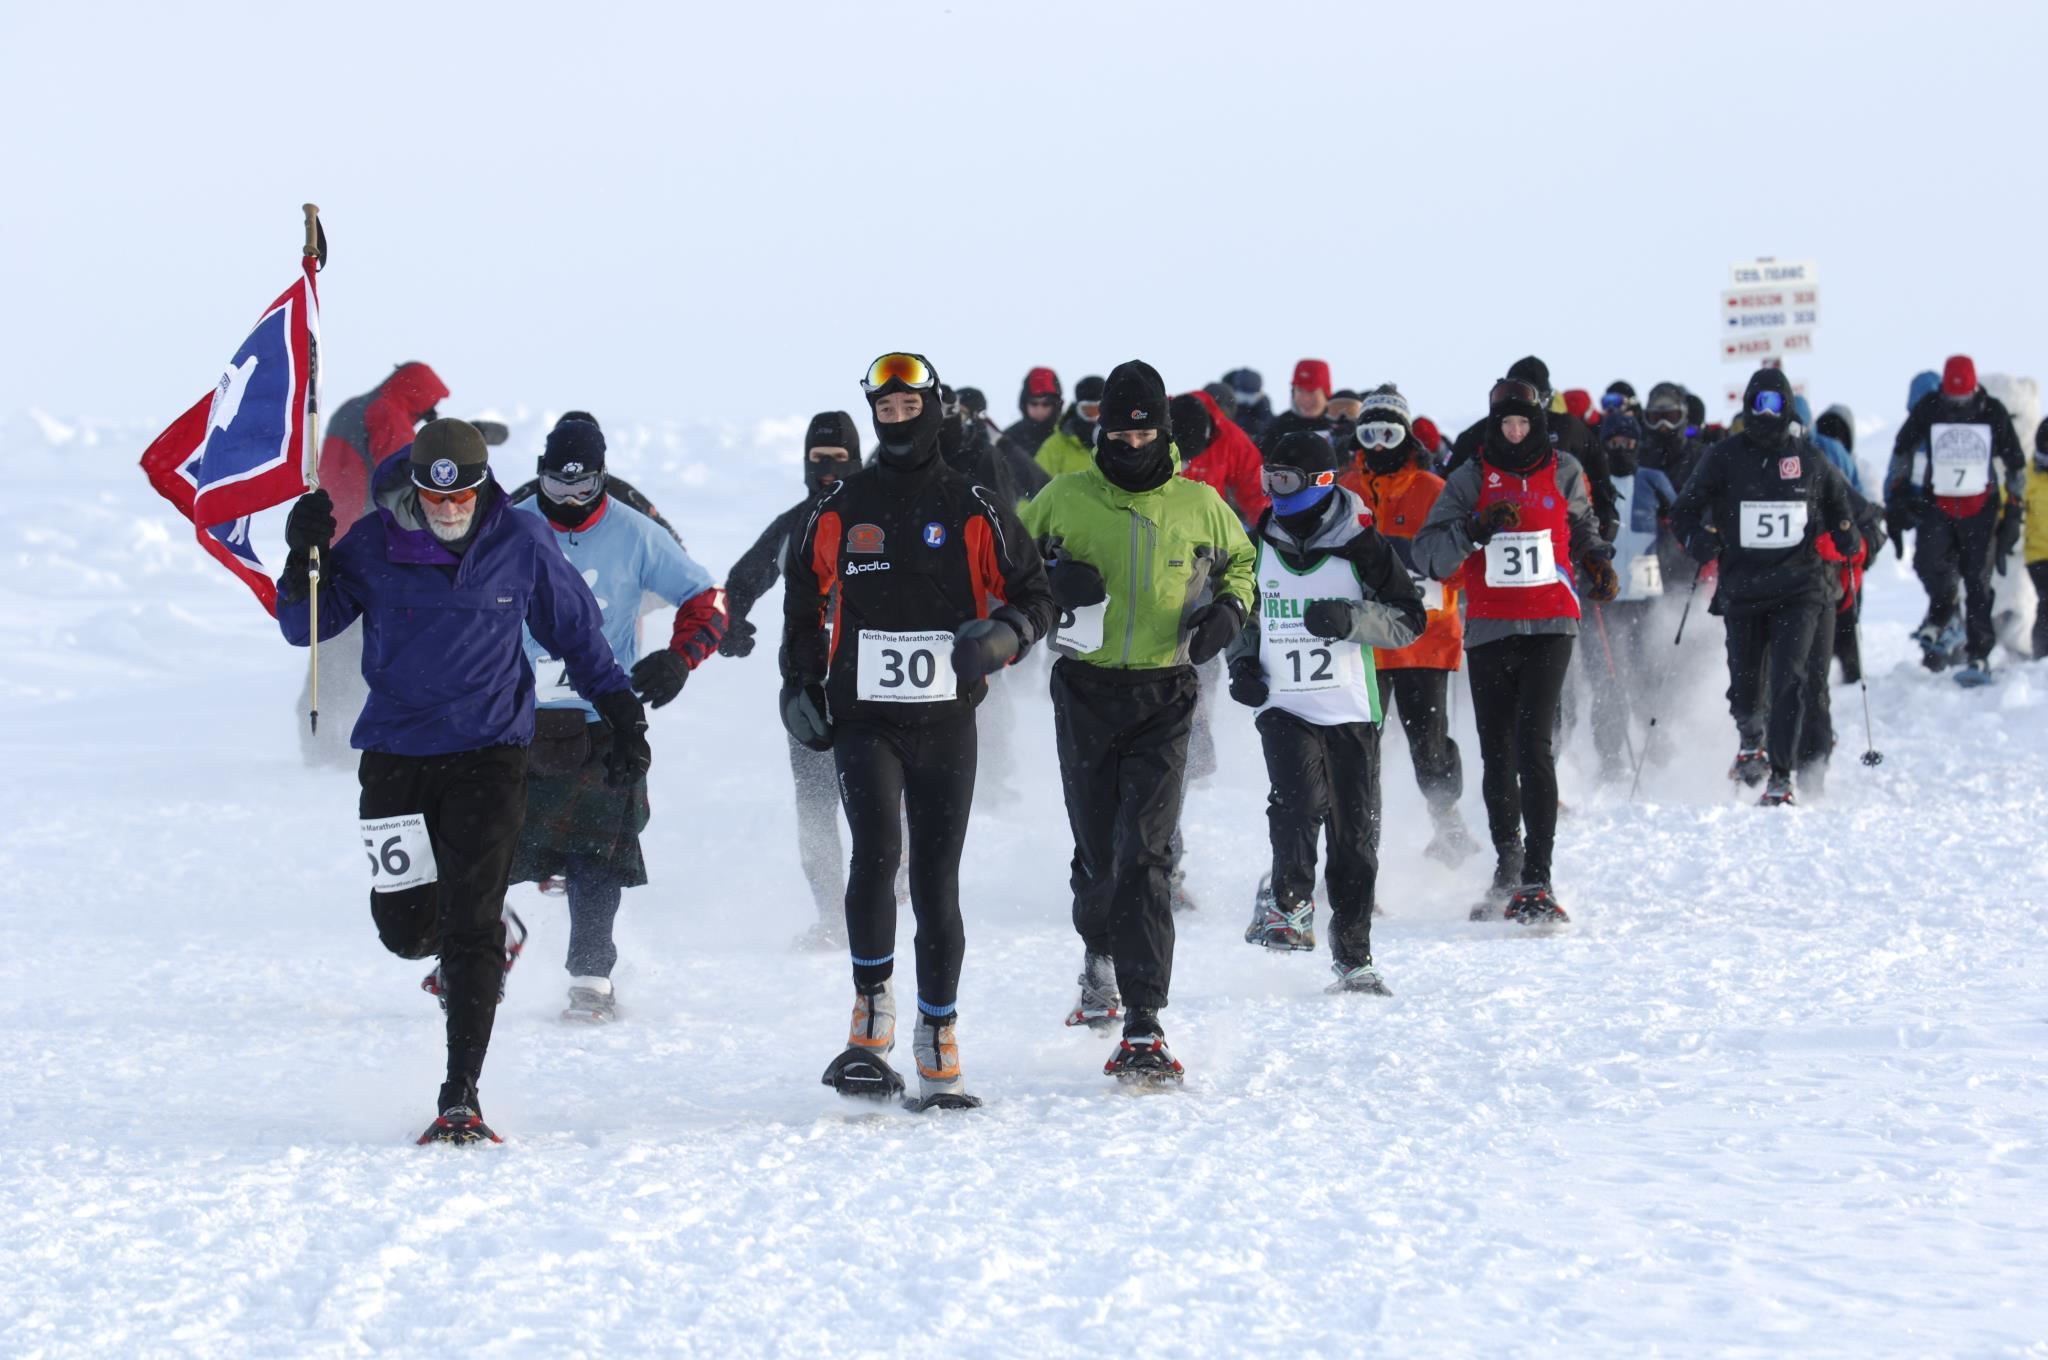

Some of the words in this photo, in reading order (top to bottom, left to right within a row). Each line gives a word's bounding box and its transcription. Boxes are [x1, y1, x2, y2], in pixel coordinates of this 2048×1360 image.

[1953, 468, 1966, 488] 7
[1756, 514, 1790, 538] 51
[1503, 546, 1539, 576] 31
[862, 633, 882, 641] North
[883, 634, 897, 643] Pole
[898, 634, 934, 643] Marathon
[935, 633, 953, 641] 2006
[879, 649, 936, 688] 30
[1286, 648, 1333, 683] 12
[366, 822, 400, 832] Marathon
[402, 819, 421, 827] 2006
